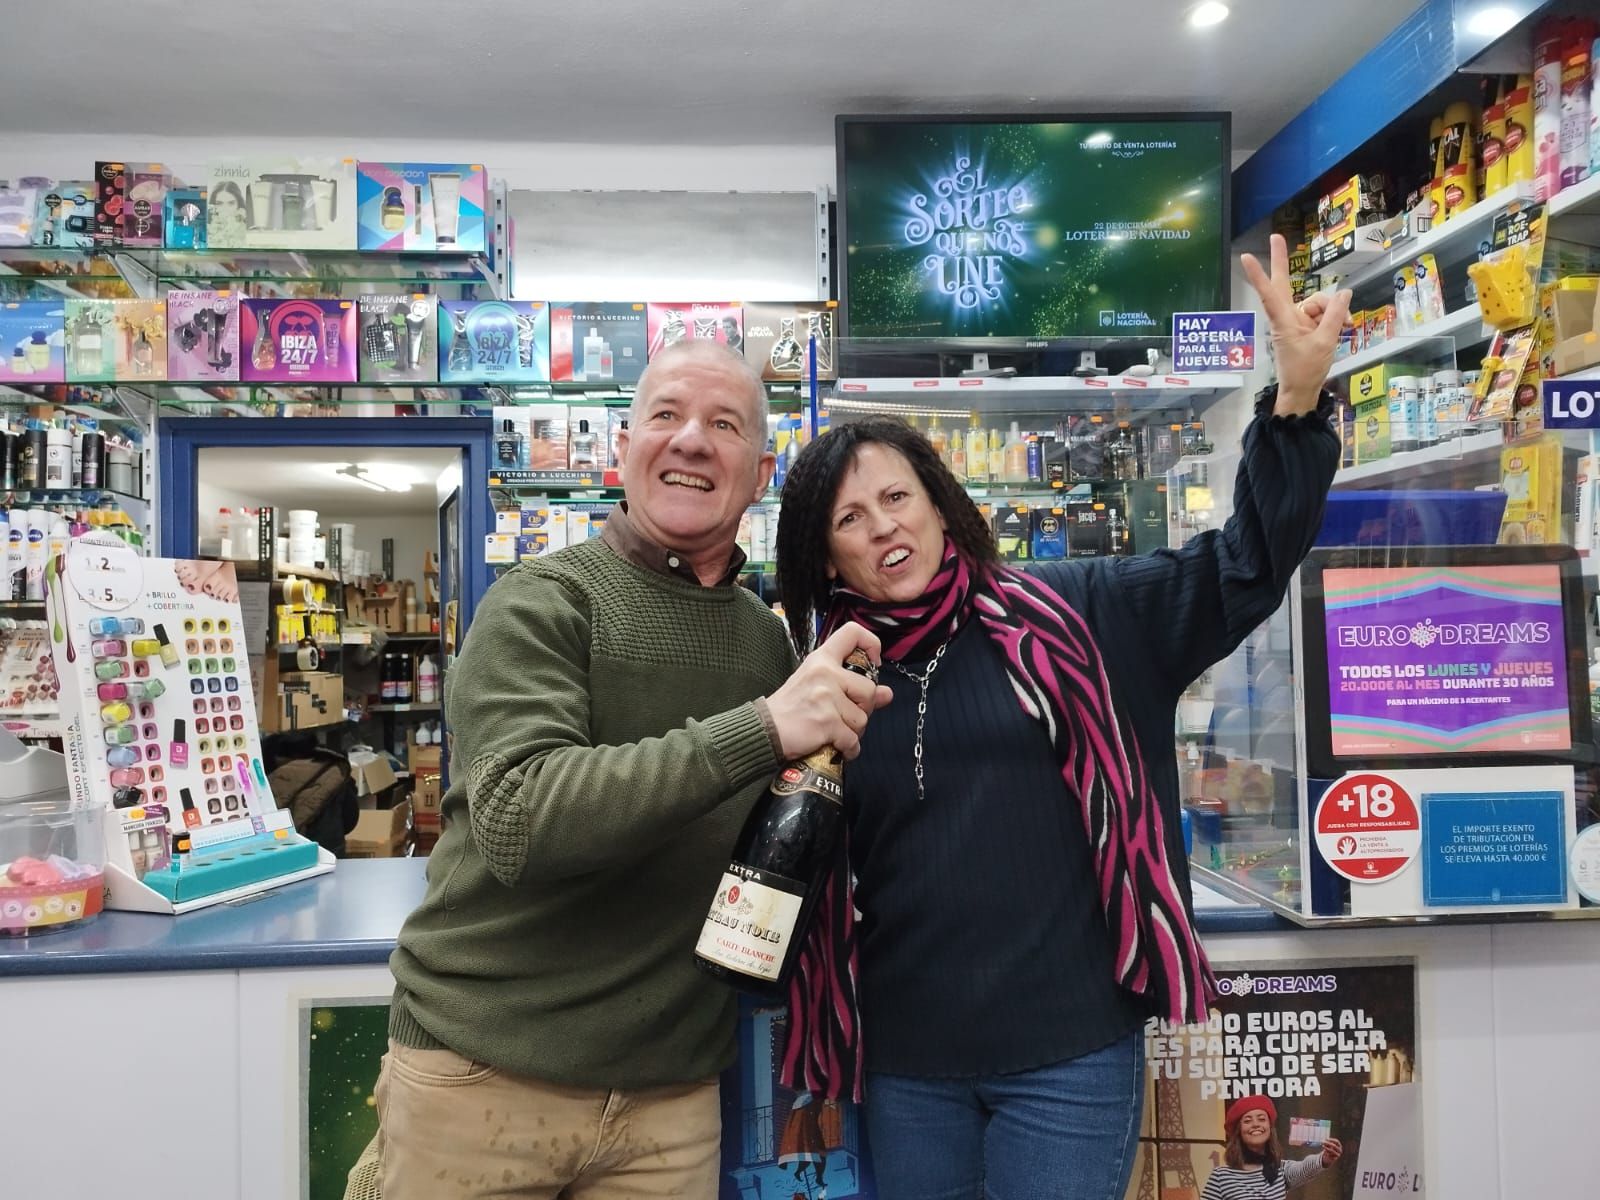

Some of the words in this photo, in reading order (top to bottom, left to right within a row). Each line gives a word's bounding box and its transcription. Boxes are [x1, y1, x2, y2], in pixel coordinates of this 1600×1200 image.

[1113, 142, 1124, 150] DE
[1124, 142, 1145, 150] VENTA
[1145, 140, 1177, 150] LOTERÍAS
[214, 165, 251, 178] zinnia
[935, 157, 988, 197] EL
[905, 186, 1028, 245] SORTEO
[936, 231, 979, 256] QUE
[984, 219, 1027, 257] NOS
[1139, 229, 1191, 241] NAVIDAD
[1507, 230, 1529, 246] TRAP
[924, 254, 1004, 308] UNE
[1117, 311, 1149, 321] LOTERÍA
[1117, 319, 1157, 328] NACIONAL
[1179, 317, 1212, 333] HAY
[281, 335, 318, 349] IBIZA
[477, 336, 511, 350] IBIZA
[1179, 328, 1246, 344] LOTERÍA
[280, 349, 318, 364] 24/7
[1178, 343, 1206, 355] PARA
[1209, 344, 1222, 354] EL
[477, 350, 512, 365] 24/7
[1176, 354, 1229, 369] JUEVES
[102, 557, 111, 571] 2
[105, 587, 114, 602] 5
[152, 591, 177, 600] BRILLO
[1338, 625, 1412, 648] EURO
[1439, 622, 1550, 646] DREAMS
[1339, 664, 1392, 679] TODOS
[1394, 663, 1425, 678] LOS
[1427, 663, 1479, 677] LUNES
[1480, 663, 1491, 676] Y
[1493, 661, 1554, 675] JUEVES
[1396, 679, 1413, 691] AL
[1415, 679, 1440, 691] MES
[1442, 678, 1501, 690] DURANTE
[1502, 678, 1518, 689] 30
[1520, 674, 1554, 688] AÑOS
[1386, 699, 1406, 707] PARA
[1418, 696, 1449, 706] MÁXIMO
[1465, 696, 1511, 705] ACERTANTES
[816, 776, 842, 796] EXTR
[1337, 783, 1396, 819] +18
[1359, 820, 1411, 829] RESPONSABILIDAD
[1453, 825, 1462, 834] EL
[1464, 825, 1501, 834] IMPORTE
[1502, 824, 1535, 833] EXENTO
[1453, 835, 1466, 843] DE
[1467, 832, 1521, 843] TRIBUTACIÓN
[1523, 833, 1535, 841] EN
[1440, 845, 1456, 855] LOS
[1457, 844, 1495, 854] PREMIOS
[1497, 844, 1508, 852] DE
[1509, 842, 1549, 852] LOTERÍAS
[1444, 856, 1455, 864] SE
[1456, 855, 1482, 864] ELEVA
[1484, 855, 1511, 863] HASTA
[1512, 854, 1541, 863] 40.000
[1541, 853, 1548, 862] €
[729, 863, 761, 881] EXTRA
[1252, 974, 1337, 995] DREAMS
[1247, 1010, 1333, 1033] EUROS
[1338, 1009, 1374, 1030] AL
[1190, 1034, 1261, 1058] PARA
[1265, 1030, 1388, 1055] CUMPLIR
[1147, 1057, 1182, 1081] TU
[1188, 1051, 1276, 1079] SUEÑO
[1281, 1054, 1316, 1076] DE
[1320, 1052, 1371, 1074] SER
[1200, 1075, 1322, 1102] PINTORA
[1361, 1171, 1396, 1190] EURO
